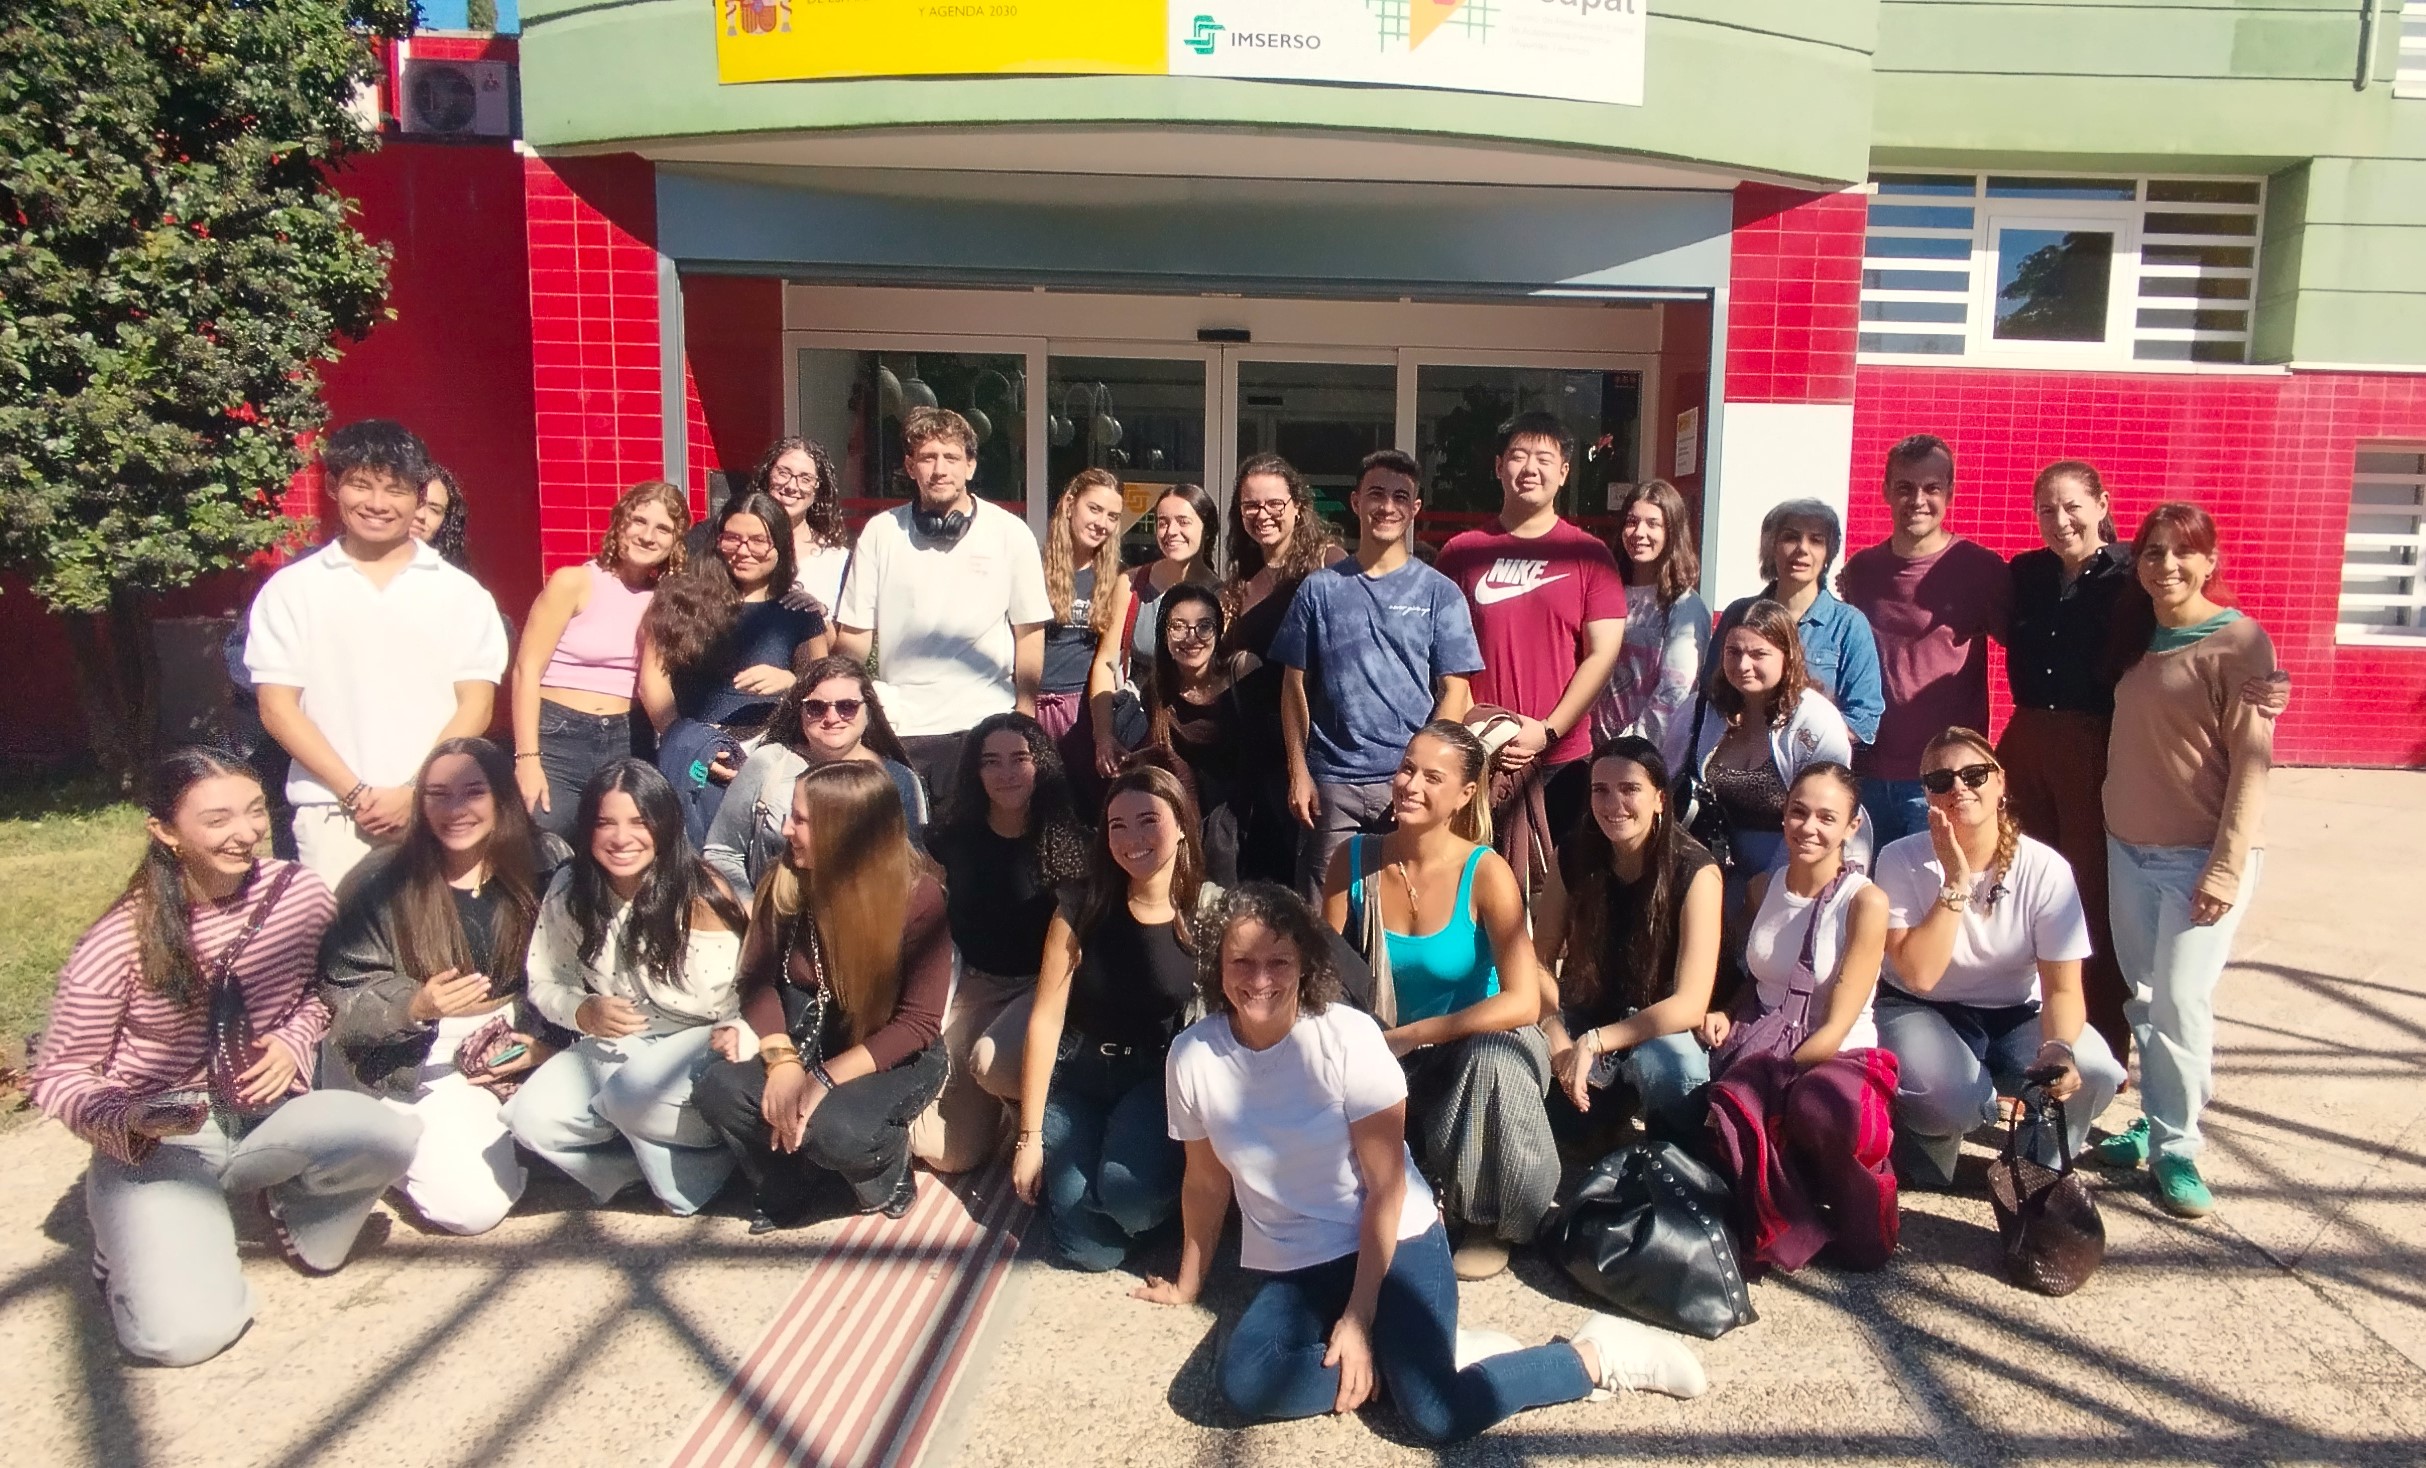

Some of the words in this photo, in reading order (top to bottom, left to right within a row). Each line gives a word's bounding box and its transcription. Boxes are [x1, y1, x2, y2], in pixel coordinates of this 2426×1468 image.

[928, 5, 985, 17] AGENDA
[989, 5, 1018, 17] 2030
[1231, 32, 1321, 50] IMSERSO
[1487, 558, 1549, 586] NIKE
